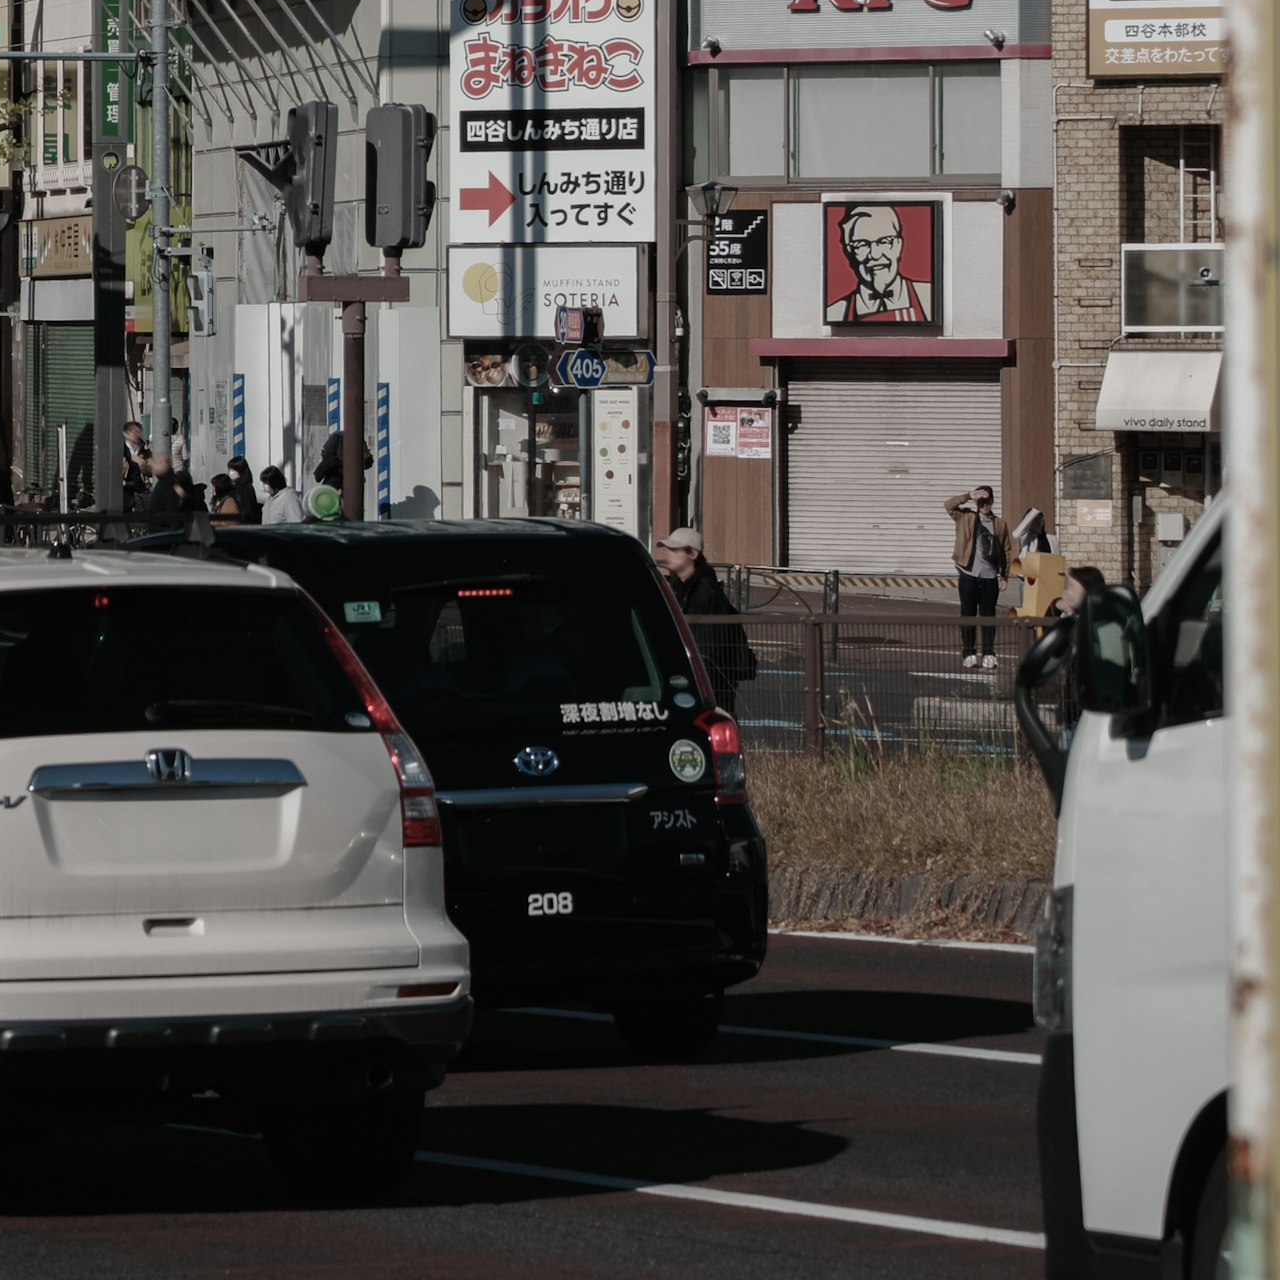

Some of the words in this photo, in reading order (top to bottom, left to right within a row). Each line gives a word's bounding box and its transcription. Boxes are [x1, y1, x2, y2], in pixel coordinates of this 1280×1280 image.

[1125, 22, 1207, 39] 四谷本部校
[461, 32, 644, 99] まねきねこ
[467, 119, 637, 142] 四谷しんみち通り店
[518, 171, 645, 196] しんみち通り
[526, 203, 636, 227] 入ってすぐ
[586, 279, 620, 287] STAND
[544, 293, 619, 308] SOTERIA
[572, 358, 601, 379] 405
[1123, 417, 1145, 427] vivo
[1149, 417, 1174, 429] daily
[1176, 418, 1206, 428] stand
[560, 702, 670, 723] 深夜割増なし
[649, 809, 697, 830] アシスト
[528, 891, 573, 916] 208
